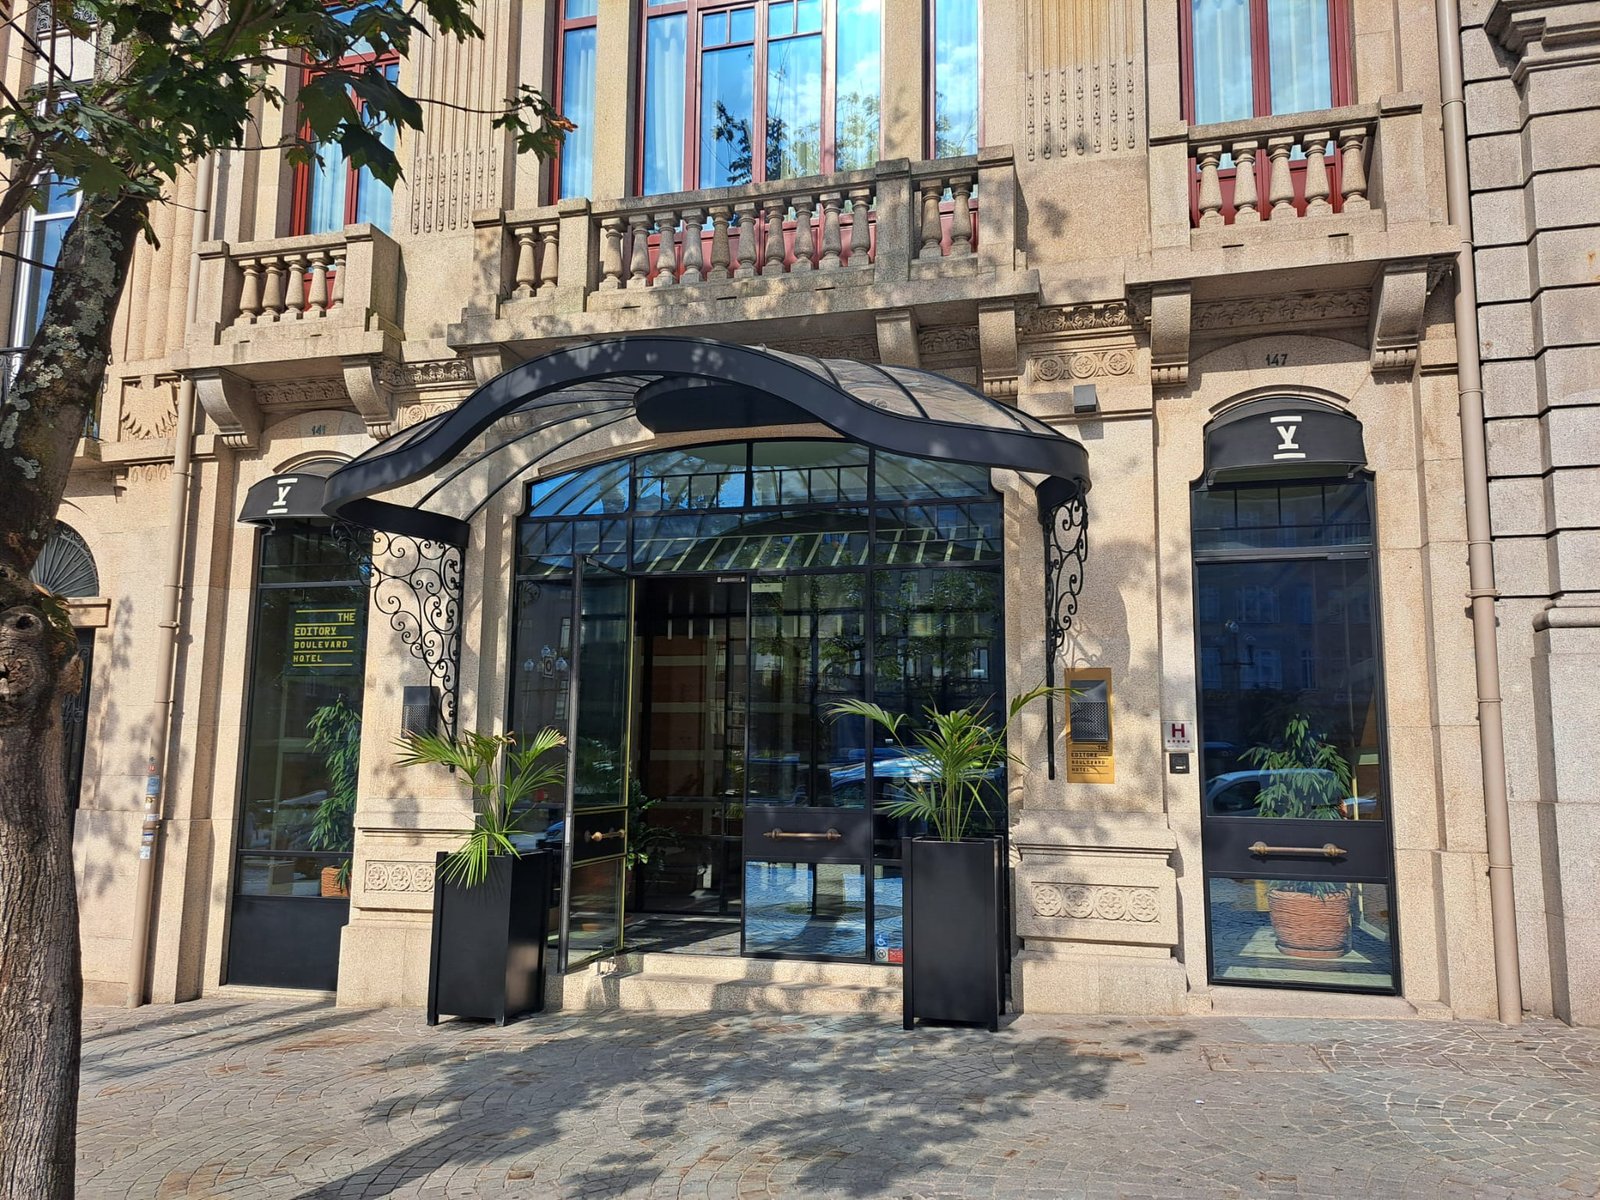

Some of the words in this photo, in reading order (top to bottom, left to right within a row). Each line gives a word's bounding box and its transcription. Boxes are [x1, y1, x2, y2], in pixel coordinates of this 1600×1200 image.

[1265, 353, 1288, 366] 147
[1276, 425, 1299, 450] Y
[272, 485, 291, 506] Y
[338, 612, 356, 622] THE
[294, 626, 337, 636] EDITORY
[293, 640, 348, 649] BOULEVARD
[293, 654, 323, 663] HOTEL
[1172, 723, 1185, 738] H
